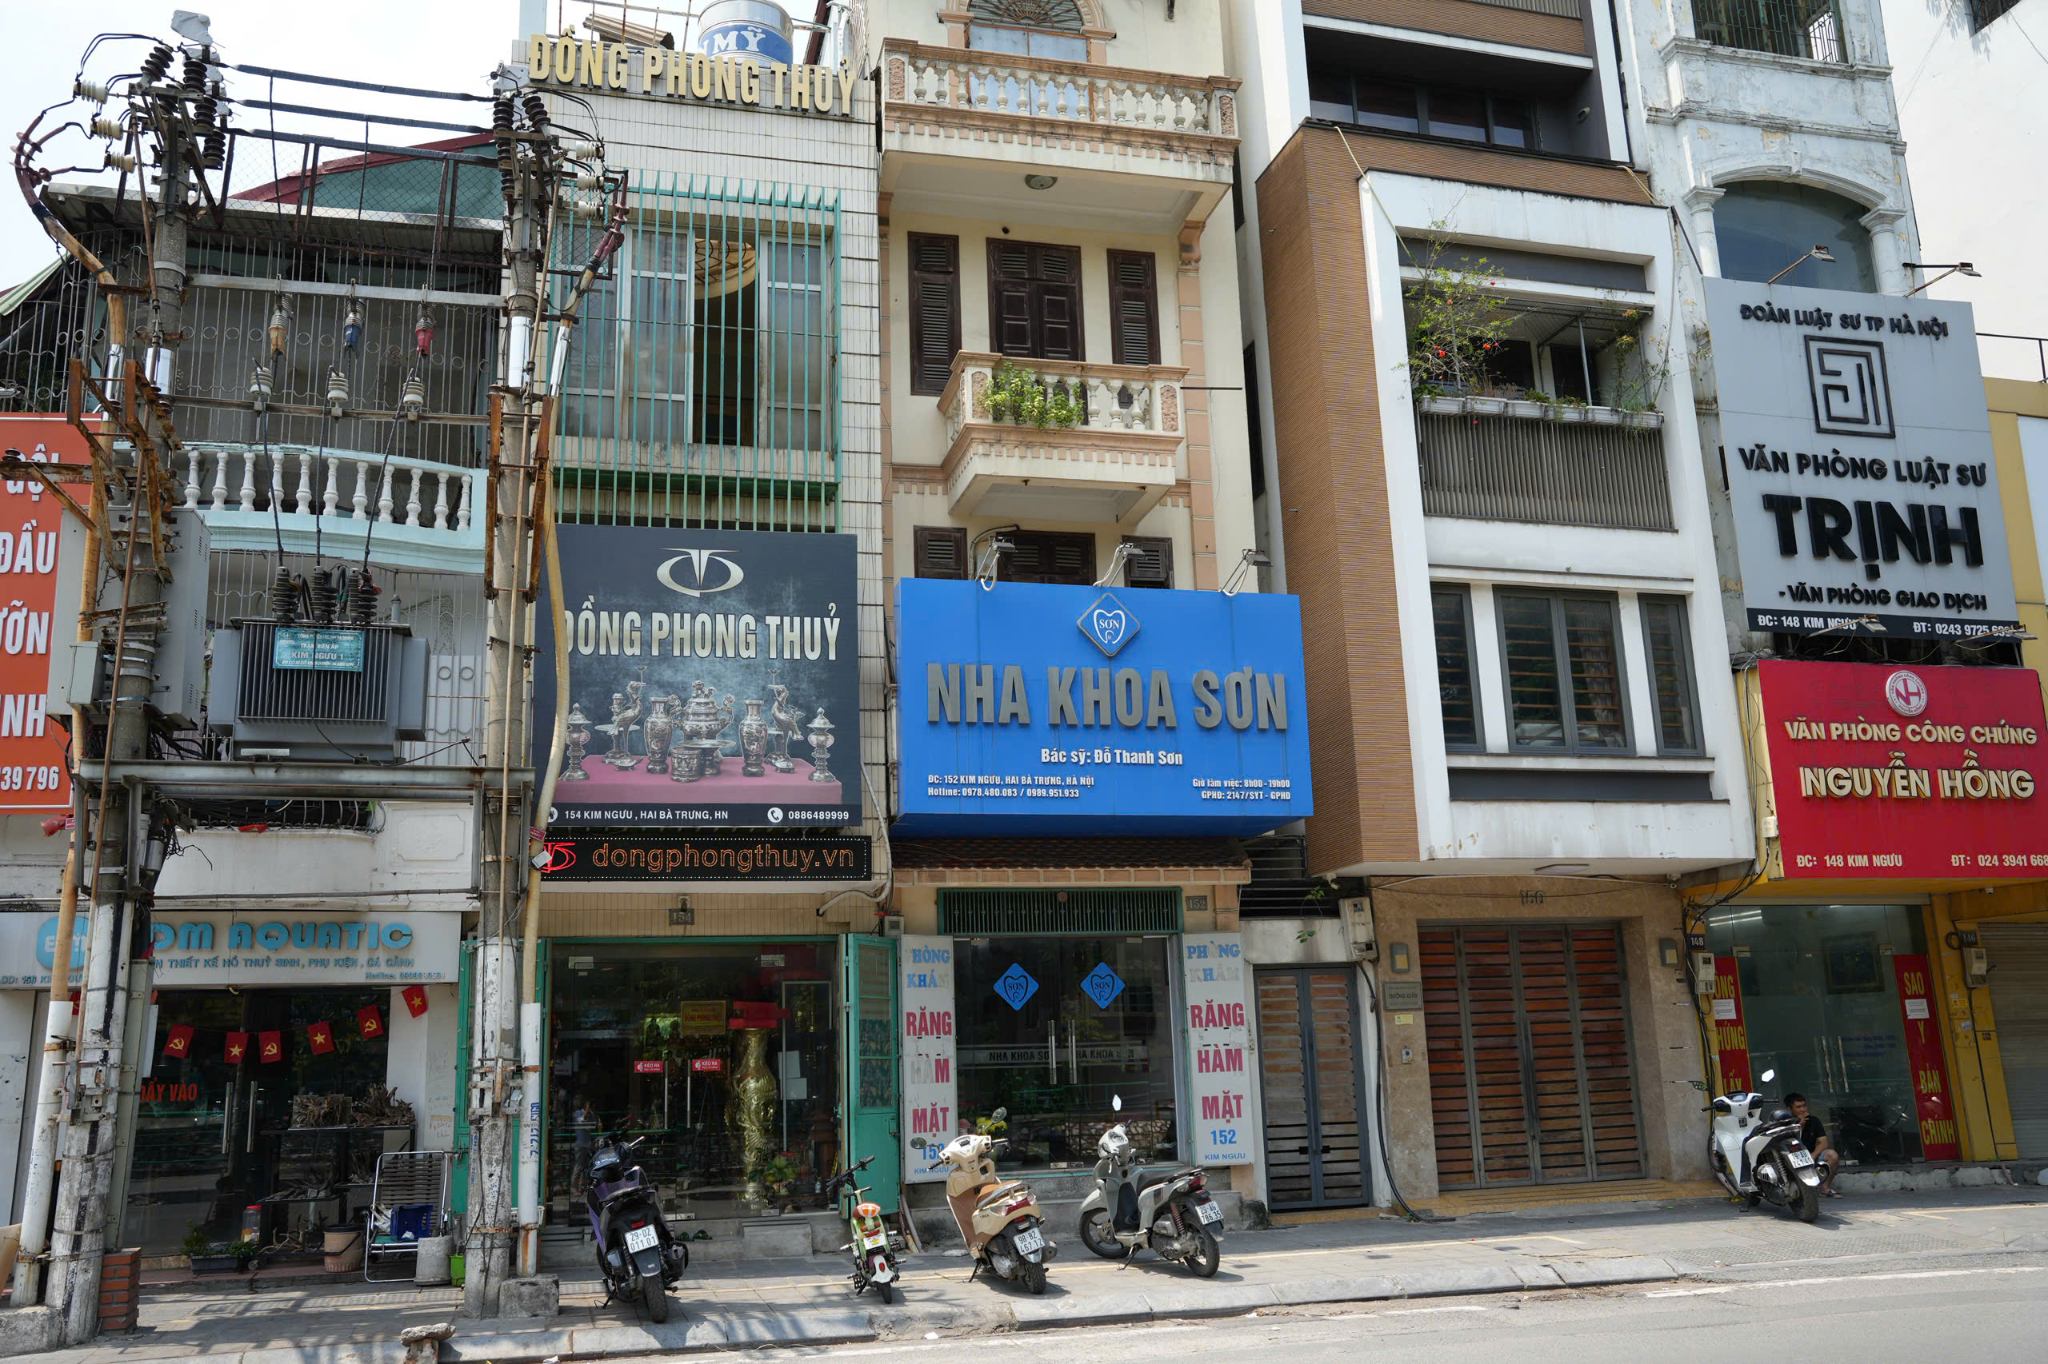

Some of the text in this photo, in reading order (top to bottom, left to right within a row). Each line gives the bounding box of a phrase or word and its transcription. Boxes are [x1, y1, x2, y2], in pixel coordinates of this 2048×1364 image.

[713, 26, 766, 53] MỸ
[529, 24, 628, 90] ĐỒNG
[643, 48, 759, 105] PHONG
[1740, 302, 1949, 341] ĐOÀN LUẬT SƯ TP HÀ NỘI
[1738, 443, 1987, 489] VĂN PHÒNG LUẬT SƯ
[1762, 493, 1984, 580] TRỊNH
[1787, 582, 1988, 614] VĂN PHÒNG GIAO DỊCH
[651, 611, 758, 660] PHONG
[766, 602, 841, 661] THUỶ
[1099, 617, 1121, 631] SƠN
[1758, 614, 1779, 627] ĐC:
[1781, 615, 1801, 629] 148
[1803, 616, 1825, 630] KIM
[1913, 621, 1933, 634] ĐT:
[1935, 623, 1962, 636] 0243
[1964, 624, 1990, 637] 9725
[927, 662, 1289, 730] NHA KHOA SƠN
[0, 693, 47, 737] NH
[1785, 716, 2038, 745] VĂN PHÒNG CÔNG CHỨNG
[1041, 746, 1184, 766] Bác sỹ: Đỗ Thanh Sơn
[26, 765, 60, 791] 796
[928, 775, 943, 785] ĐC:
[944, 775, 958, 785] 152
[960, 775, 976, 785] KIM
[1006, 776, 1019, 786] HAI
[1021, 774, 1032, 786] BÀ
[1067, 775, 1078, 786] HÀ
[1080, 776, 1095, 789] NỘI
[1244, 779, 1263, 788] 8h00
[1799, 748, 2035, 799] NGUYỄN HỒNG
[928, 787, 961, 797] Hotline:
[565, 811, 581, 820] 154
[583, 811, 601, 820] KIM
[640, 811, 657, 820] HAI
[659, 809, 673, 820] BÀ
[714, 811, 728, 820] HN
[788, 811, 849, 820] 0886489999
[592, 844, 854, 873] dongphongthuy.vn
[1797, 853, 1903, 868] ĐC: 148 KIM NGƯU
[1951, 854, 1971, 867] ĐT:
[1978, 854, 1999, 867] 024
[2003, 854, 2028, 867] 3941
[228, 921, 414, 951] AQUATIC
[1690, 937, 1704, 947] 148
[911, 945, 950, 964] HÒNG
[1904, 972, 1925, 995] SAO
[906, 1006, 952, 1037] RĂNG
[1191, 999, 1245, 1029] RĂNG
[1197, 1045, 1243, 1073] HÀM
[1202, 1090, 1243, 1123] MẶT
[912, 1103, 949, 1138] MẶT
[1211, 1130, 1237, 1145] 152
